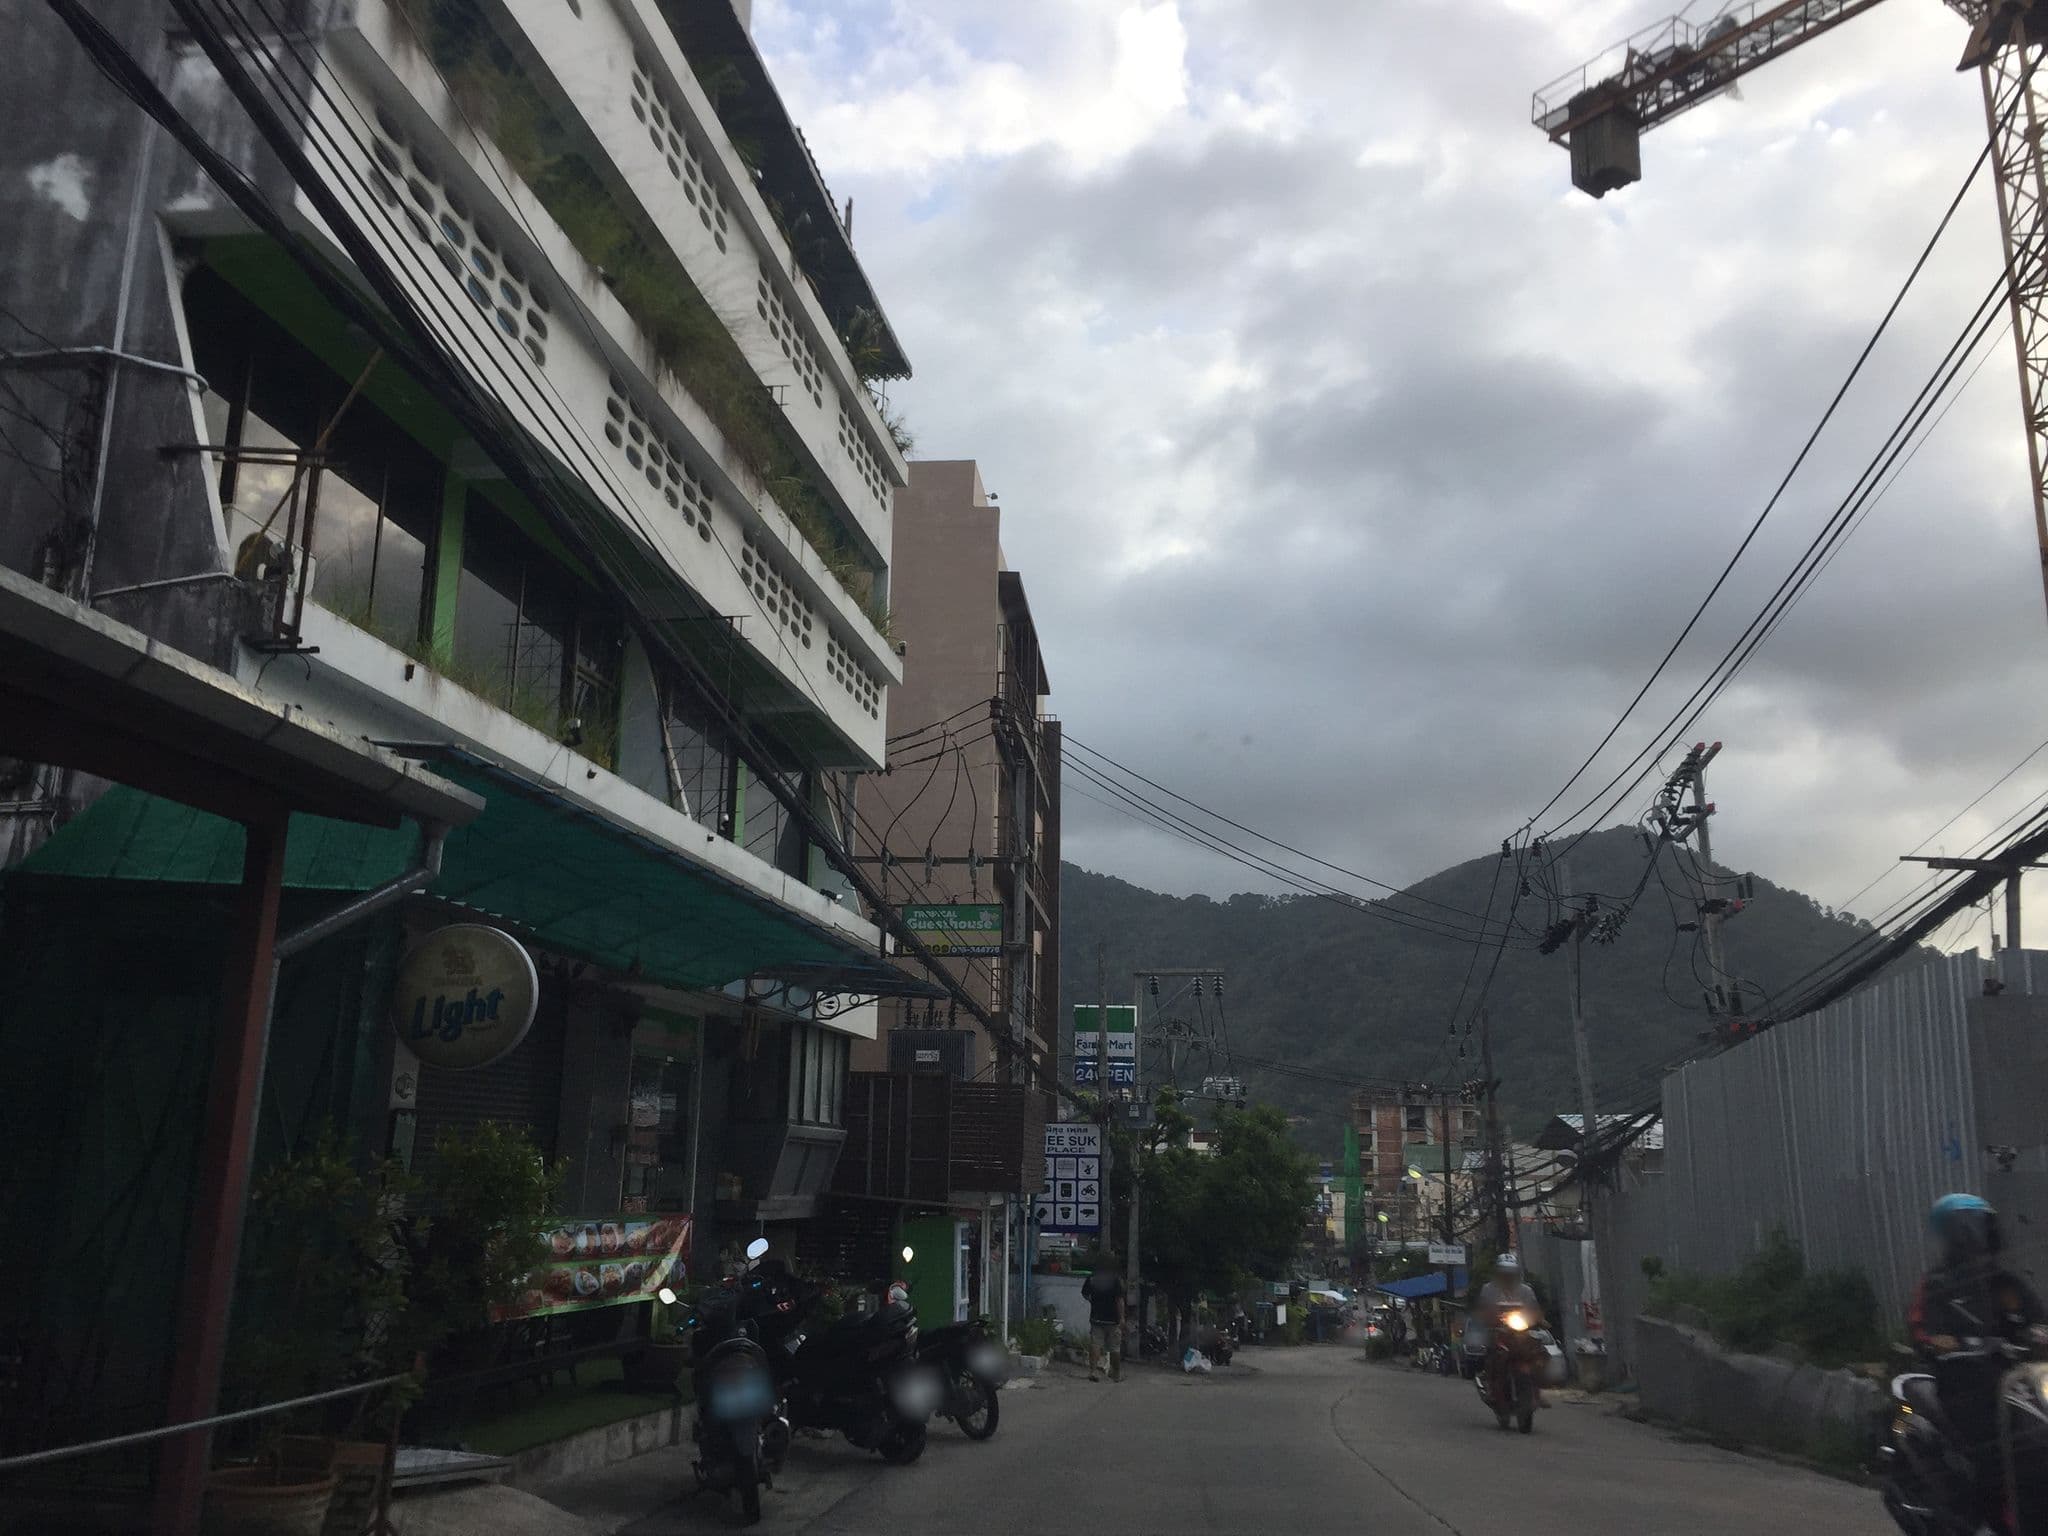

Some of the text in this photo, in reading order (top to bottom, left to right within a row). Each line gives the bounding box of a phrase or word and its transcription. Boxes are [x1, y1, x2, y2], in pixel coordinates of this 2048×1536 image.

[906, 918, 993, 930] Guesthouse
[411, 987, 505, 1041] Light
[1047, 1136, 1097, 1146] EE SUK
